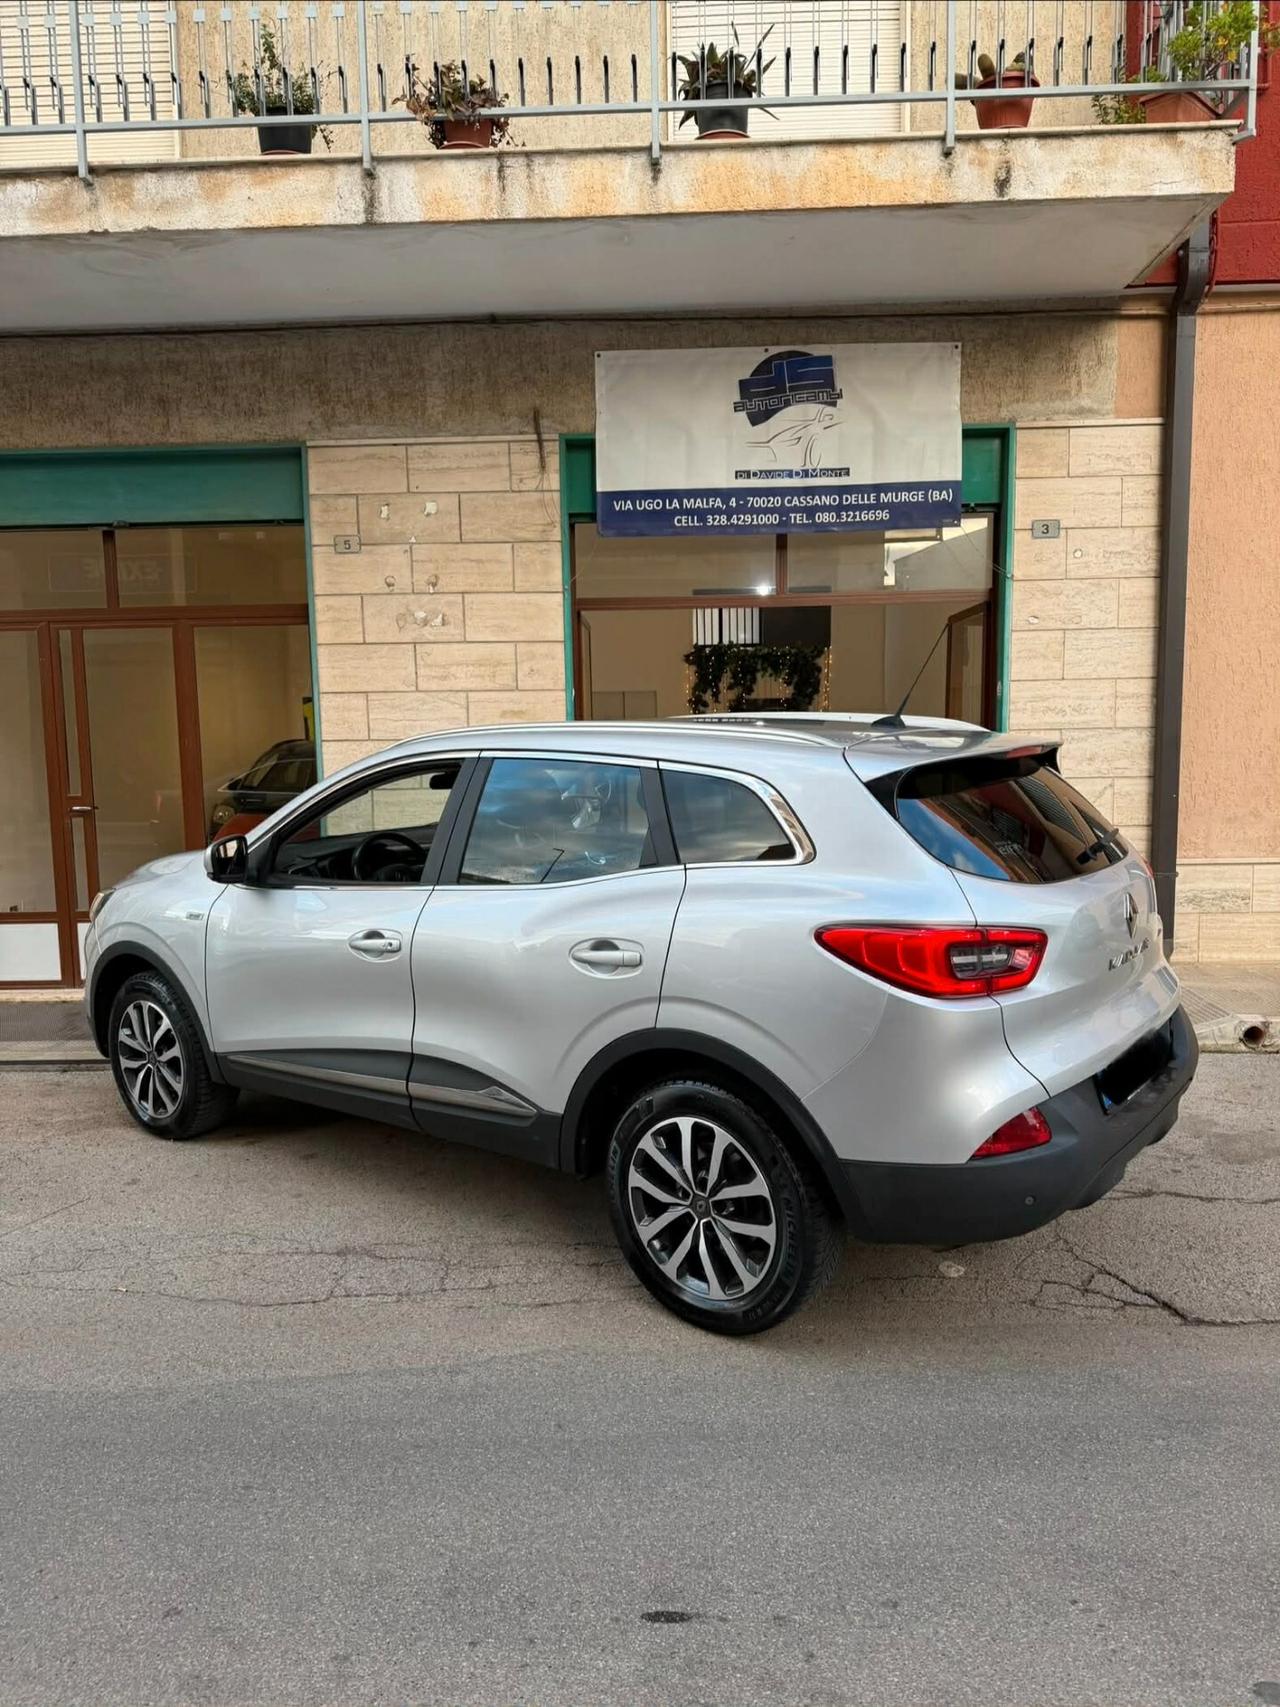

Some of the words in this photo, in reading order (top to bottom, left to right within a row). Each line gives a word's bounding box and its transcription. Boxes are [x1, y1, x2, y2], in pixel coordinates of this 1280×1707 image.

[808, 468, 849, 478] MONTE
[613, 499, 633, 512] VIA
[636, 499, 663, 511] UGO
[665, 498, 680, 510] LA
[683, 497, 727, 510] MALFA,
[729, 497, 736, 508] 4
[747, 496, 782, 508] 70020
[784, 495, 840, 507] CASSANO
[842, 493, 877, 505] DELLE
[880, 490, 925, 503] MURGE
[928, 488, 953, 503] (BA)
[674, 515, 703, 527] CELL.
[706, 513, 779, 526] 328.4291000
[789, 513, 812, 524] TEL.
[815, 509, 890, 524] 080.3216696
[1041, 523, 1050, 535] 3
[343, 539, 351, 550] 5
